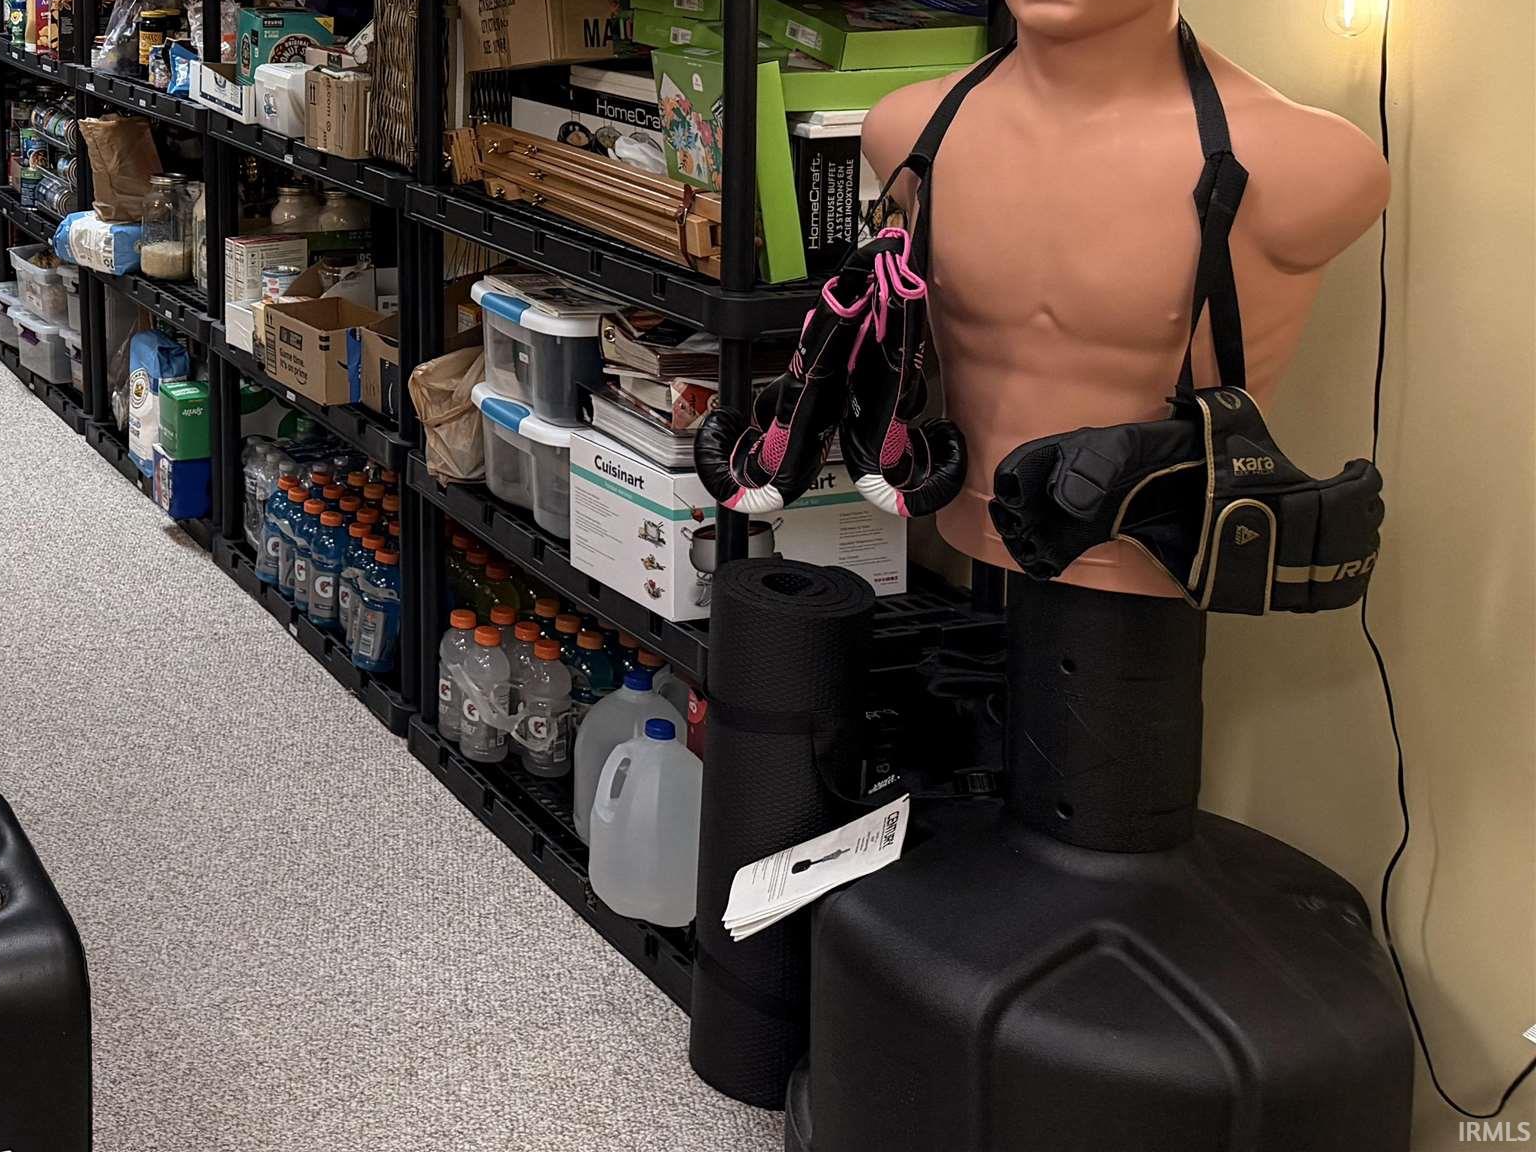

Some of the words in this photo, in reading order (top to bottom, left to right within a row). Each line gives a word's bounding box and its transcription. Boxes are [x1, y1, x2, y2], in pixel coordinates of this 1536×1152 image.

[596, 100, 662, 130] HomeCra
[828, 162, 836, 195] BUFFET
[837, 165, 845, 179] EN
[845, 159, 854, 216] INOXYDABLE
[836, 179, 845, 226] STATIONS
[827, 196, 835, 244] MIJOTEUSE
[844, 217, 852, 244] ACIER
[182, 407, 203, 417] Sprite
[594, 454, 645, 490] Cuisinart
[1232, 456, 1275, 472] Kara
[883, 811, 899, 848] CENTURY
